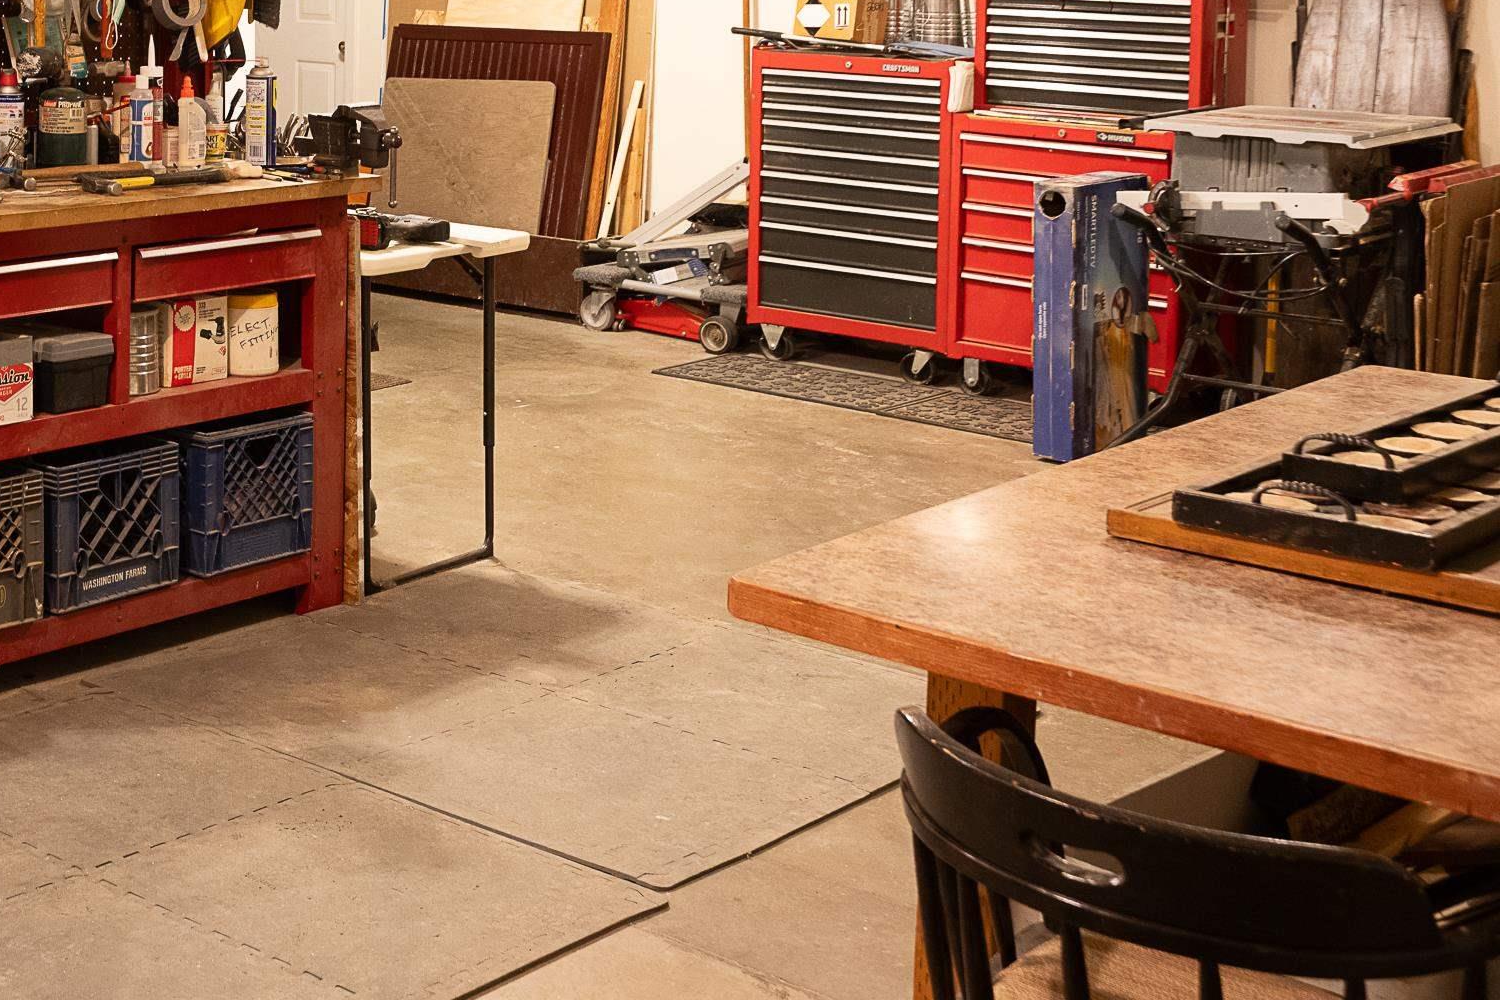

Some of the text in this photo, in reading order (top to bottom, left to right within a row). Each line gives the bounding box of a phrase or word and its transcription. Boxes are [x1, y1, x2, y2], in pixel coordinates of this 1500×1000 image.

[882, 63, 920, 73] CRAFTSMAN
[58, 100, 82, 108] PROPANE
[1108, 134, 1134, 144] HUSKY
[1090, 194, 1098, 231] SMART
[1090, 254, 1097, 268] TV
[16, 397, 28, 412] 12
[82, 565, 148, 591] WASHINGTON FARMS
